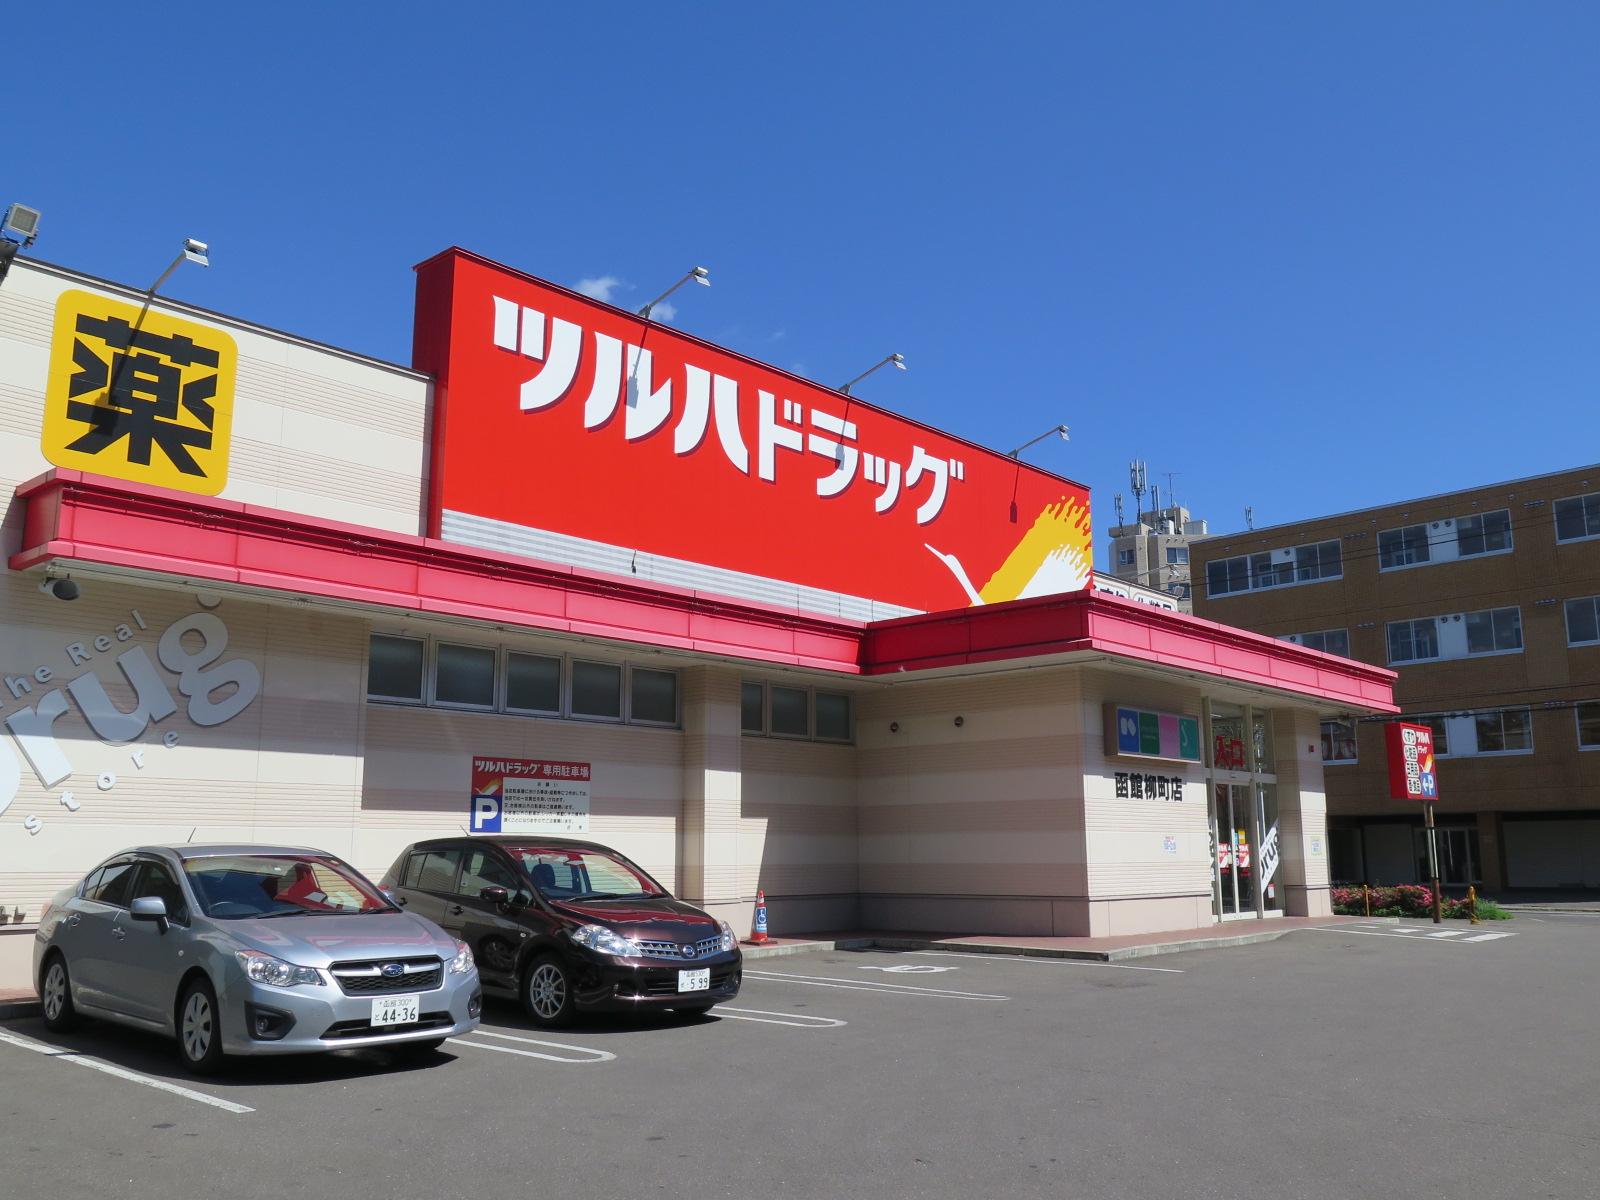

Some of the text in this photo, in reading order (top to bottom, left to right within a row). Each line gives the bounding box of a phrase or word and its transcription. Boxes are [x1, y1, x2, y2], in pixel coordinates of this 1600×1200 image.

[64, 313, 220, 478] 薬
[492, 294, 965, 524] ツルハドラッグ
[0, 609, 148, 709] he Real
[1215, 735, 1244, 768] 入口
[475, 760, 589, 778] ツルハドラッグ 専用駐車場
[1114, 772, 1183, 801] 函館柳町店
[475, 798, 499, 829] P
[381, 1007, 416, 1023] 44-36
